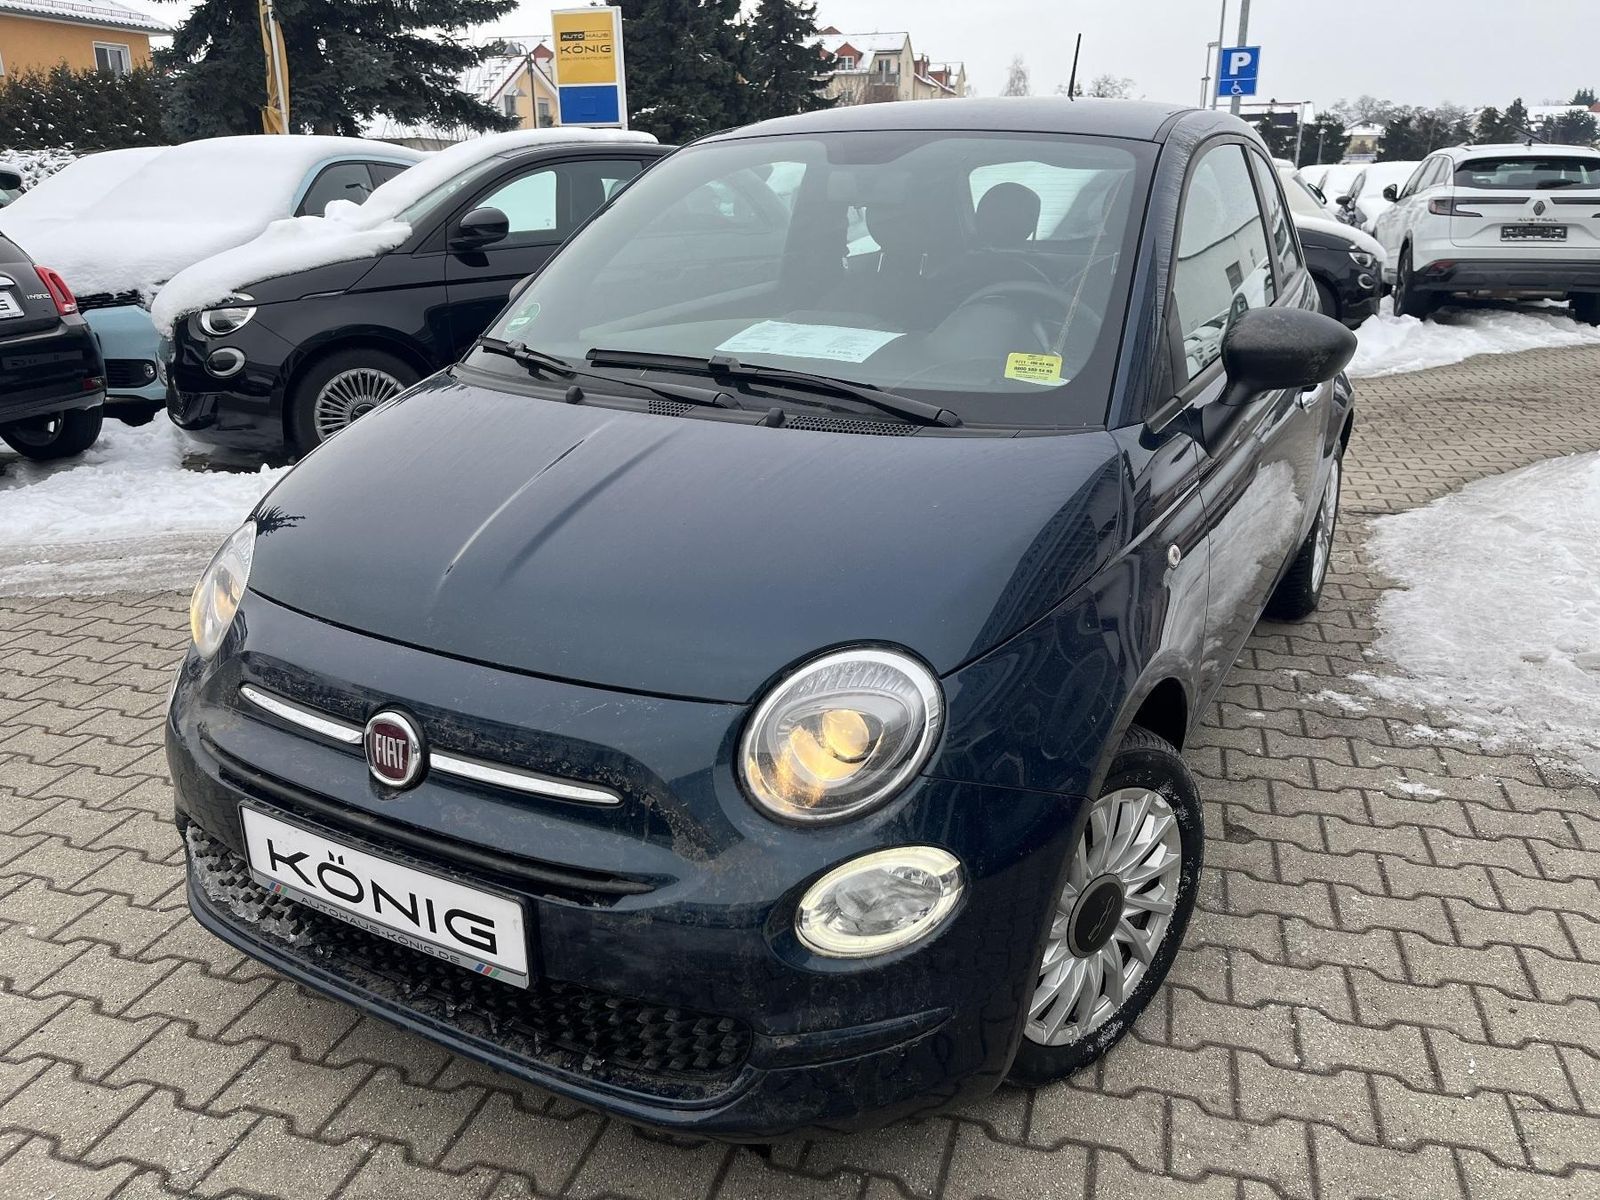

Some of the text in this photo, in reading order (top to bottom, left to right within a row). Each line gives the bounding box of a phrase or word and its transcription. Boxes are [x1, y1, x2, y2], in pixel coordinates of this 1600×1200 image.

[560, 43, 611, 54] KÖNIG
[1229, 52, 1252, 75] P
[375, 732, 407, 770] FIAT
[266, 838, 498, 956] KÖNIG
[301, 897, 461, 964] AUTOHAUS-KÖNIG.DE
